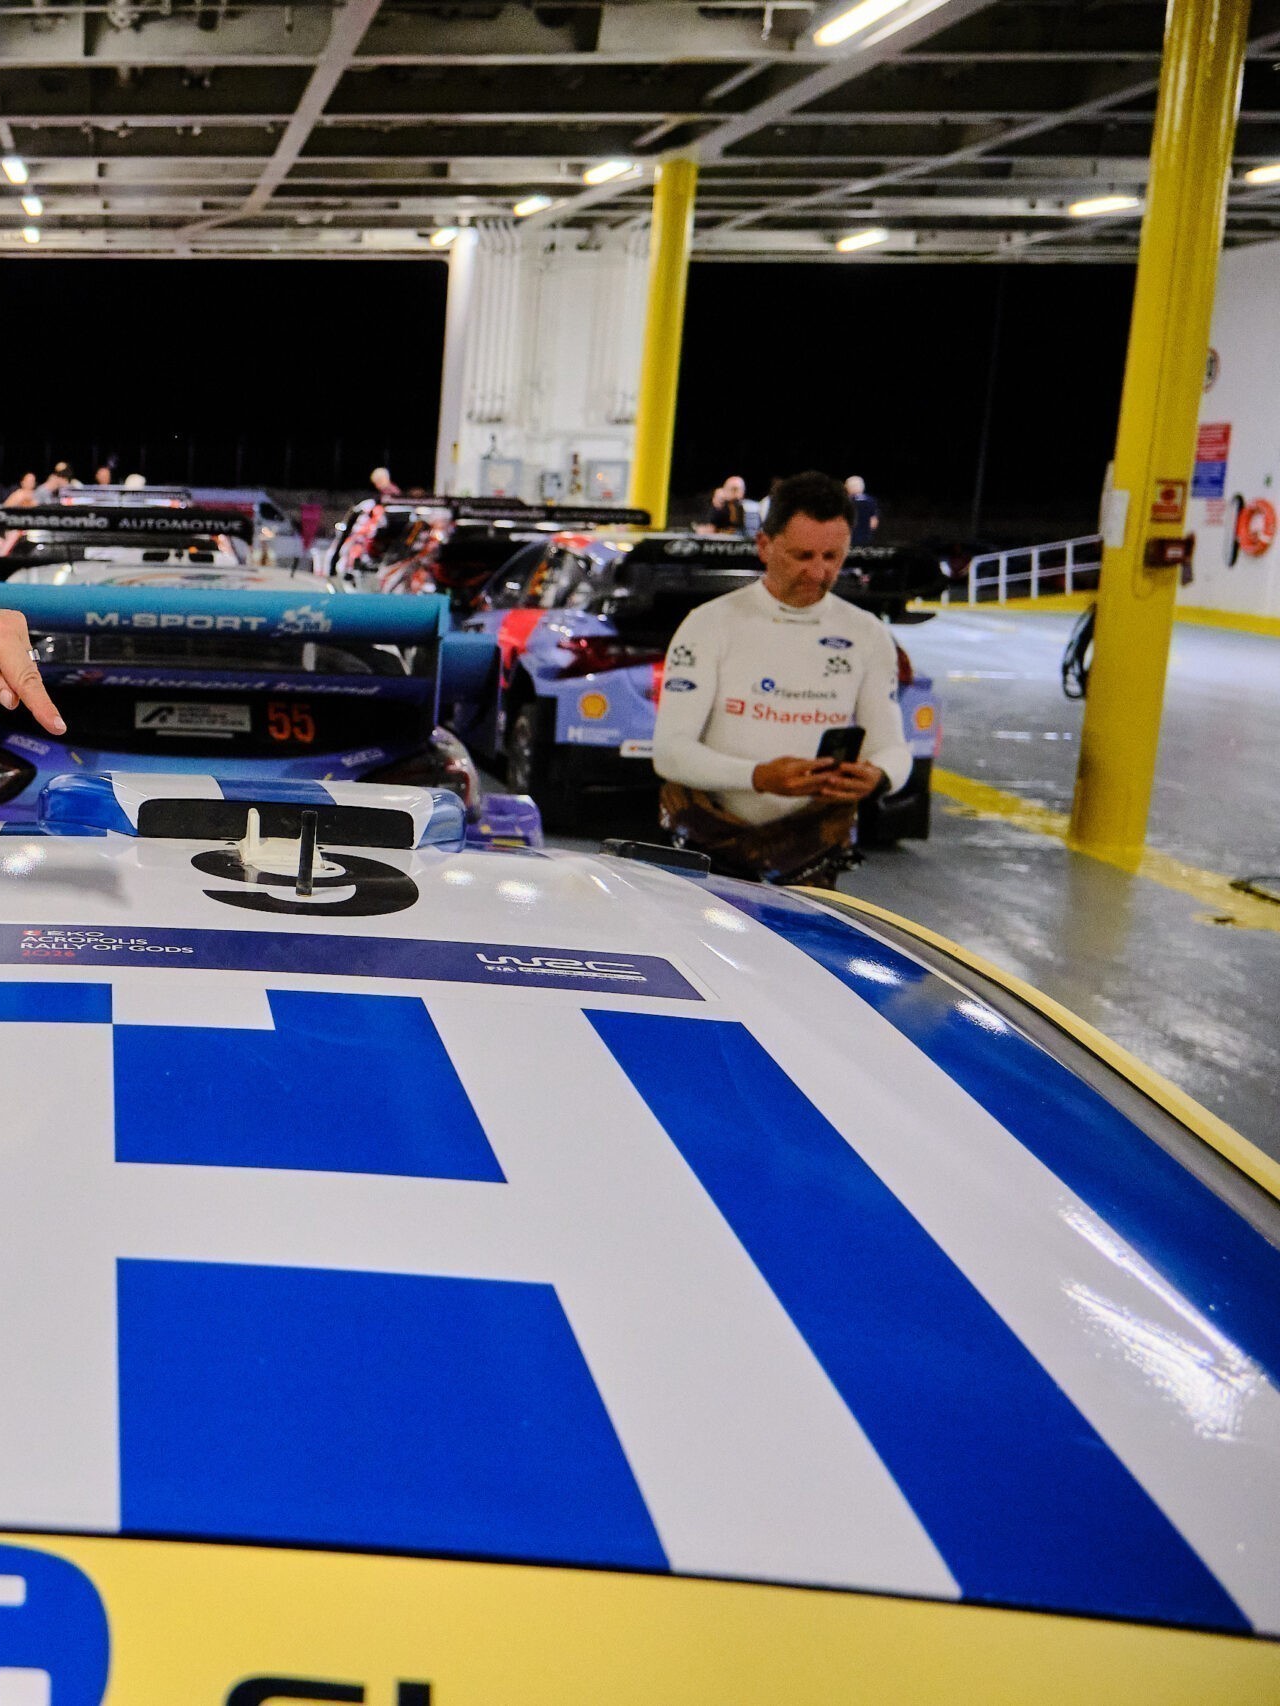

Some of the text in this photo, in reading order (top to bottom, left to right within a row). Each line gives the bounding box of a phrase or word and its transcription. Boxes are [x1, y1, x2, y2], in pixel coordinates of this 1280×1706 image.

[119, 517, 244, 532] AUTOMOTIVE
[85, 611, 268, 631] M-SPORT
[268, 702, 315, 743] 55
[20, 943, 90, 951] RALLY
[128, 945, 195, 954] GODS
[22, 936, 148, 945] ACROPOLIS
[476, 953, 642, 976] WRC
